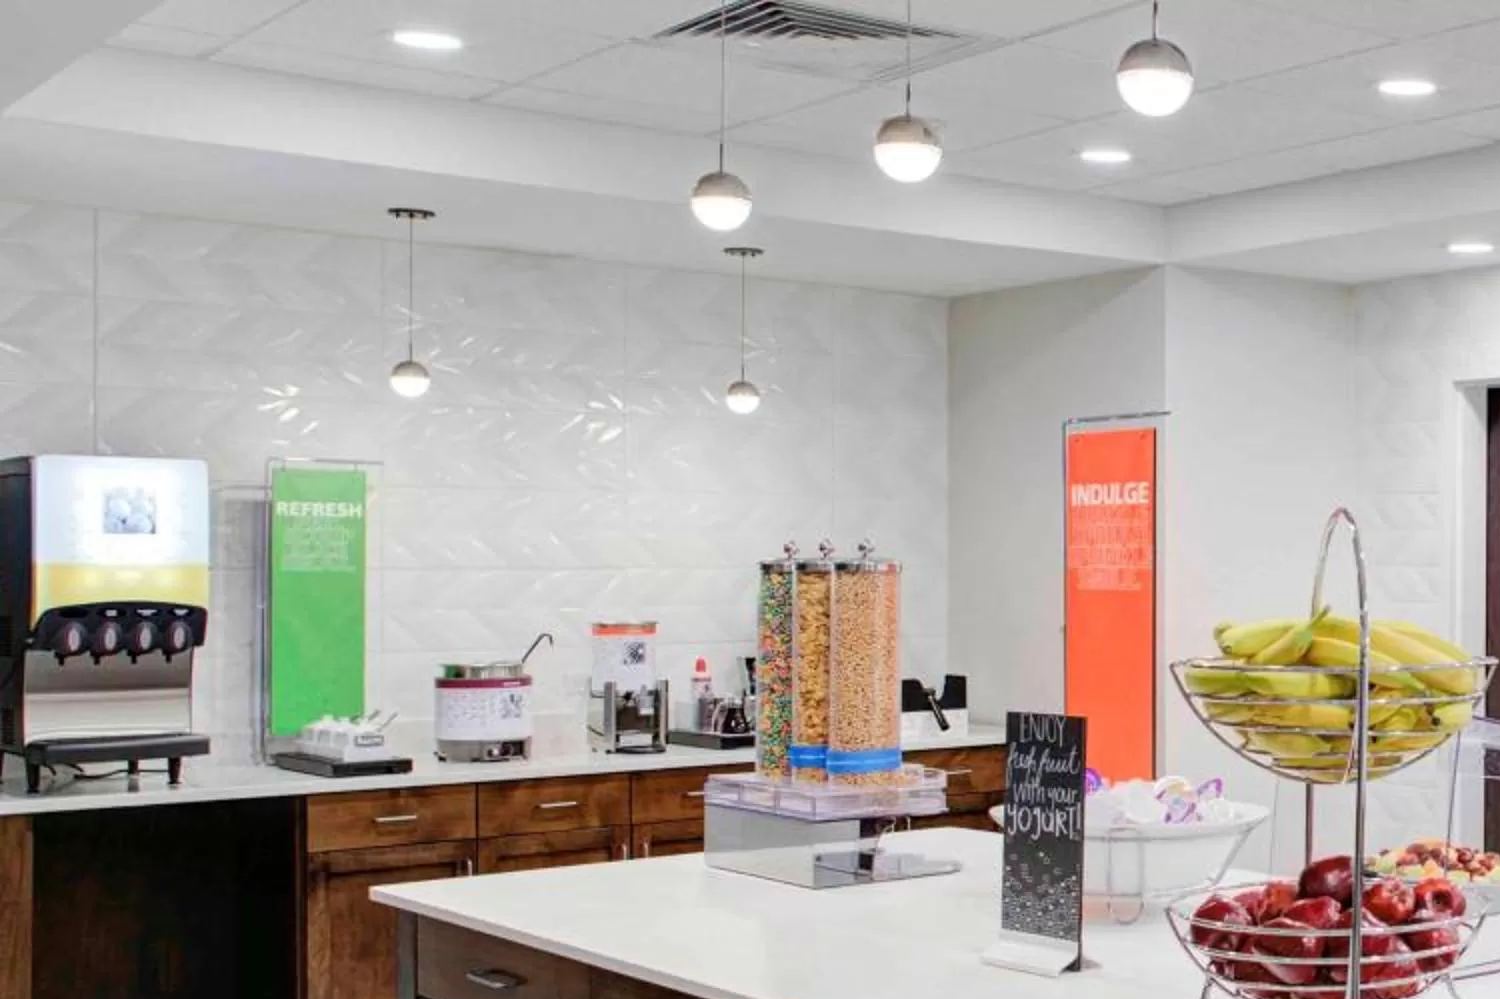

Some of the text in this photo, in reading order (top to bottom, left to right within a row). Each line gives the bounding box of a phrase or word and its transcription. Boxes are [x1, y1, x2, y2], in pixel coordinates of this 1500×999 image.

[1071, 482, 1150, 505] INDULGE
[276, 501, 363, 519] REFRESH
[1020, 711, 1066, 748] ENJOY
[1036, 747, 1080, 786] fruit
[1047, 786, 1079, 813] your
